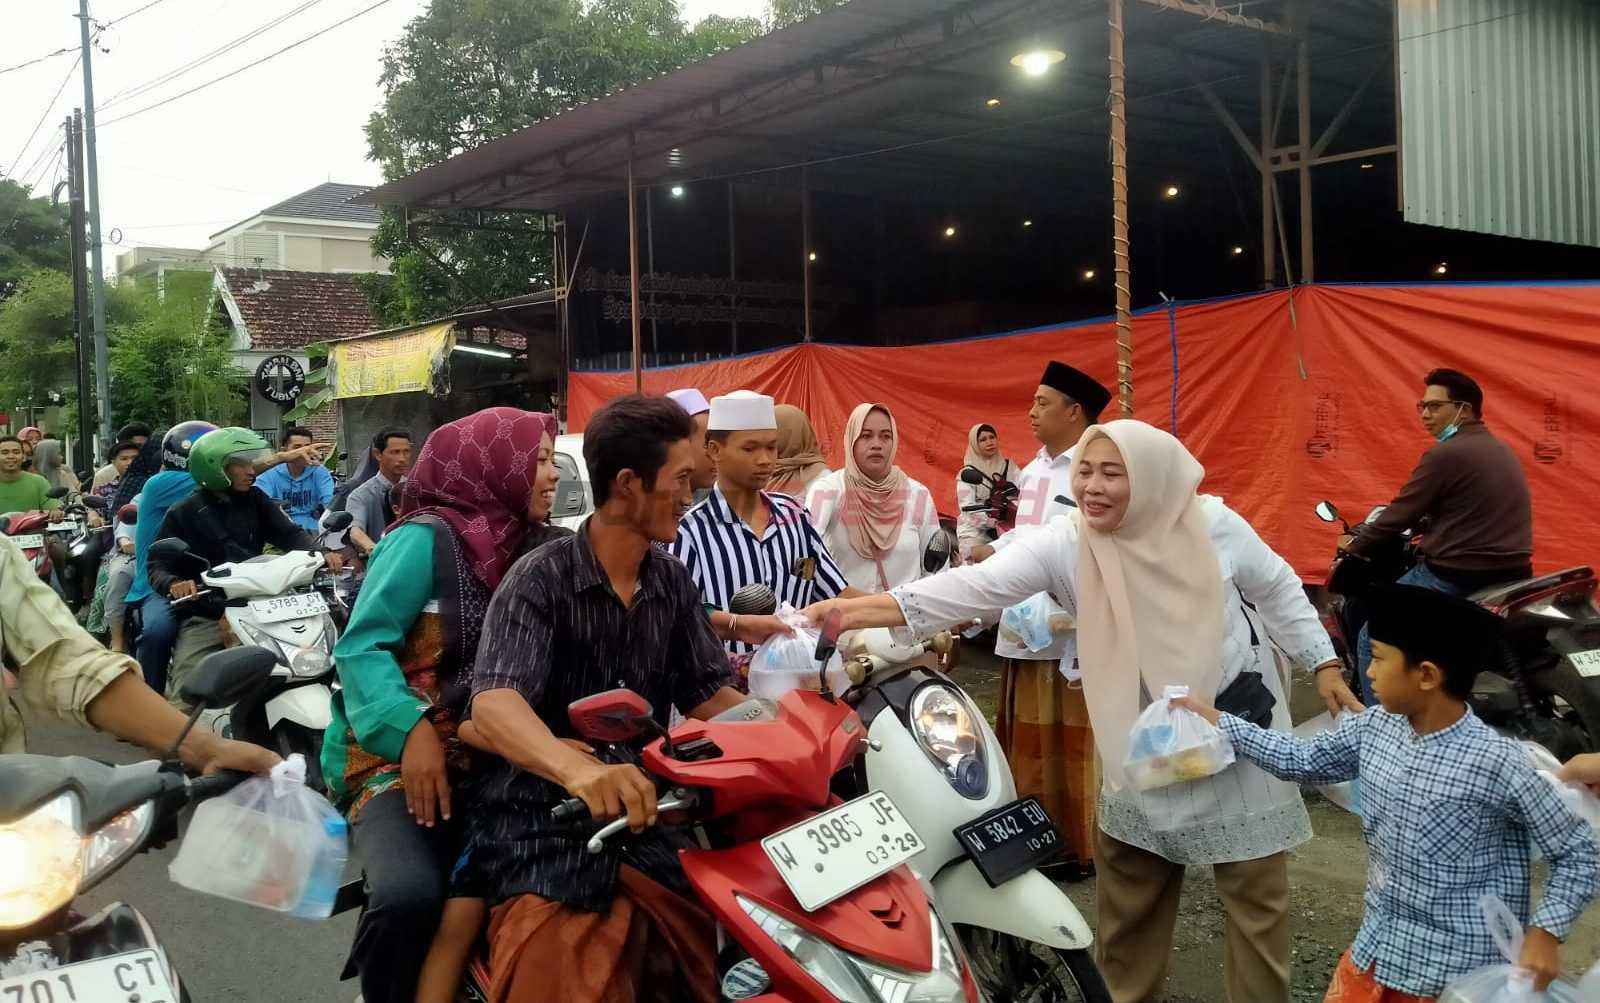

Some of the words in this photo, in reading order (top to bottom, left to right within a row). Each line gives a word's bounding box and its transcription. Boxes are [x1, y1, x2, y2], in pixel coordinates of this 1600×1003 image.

[268, 596, 299, 609] 5789
[772, 840, 799, 871] W
[806, 812, 863, 855] 3985
[869, 796, 895, 826] JF
[967, 832, 987, 852] W
[984, 815, 1023, 844] 5842
[113, 957, 156, 992] CT
